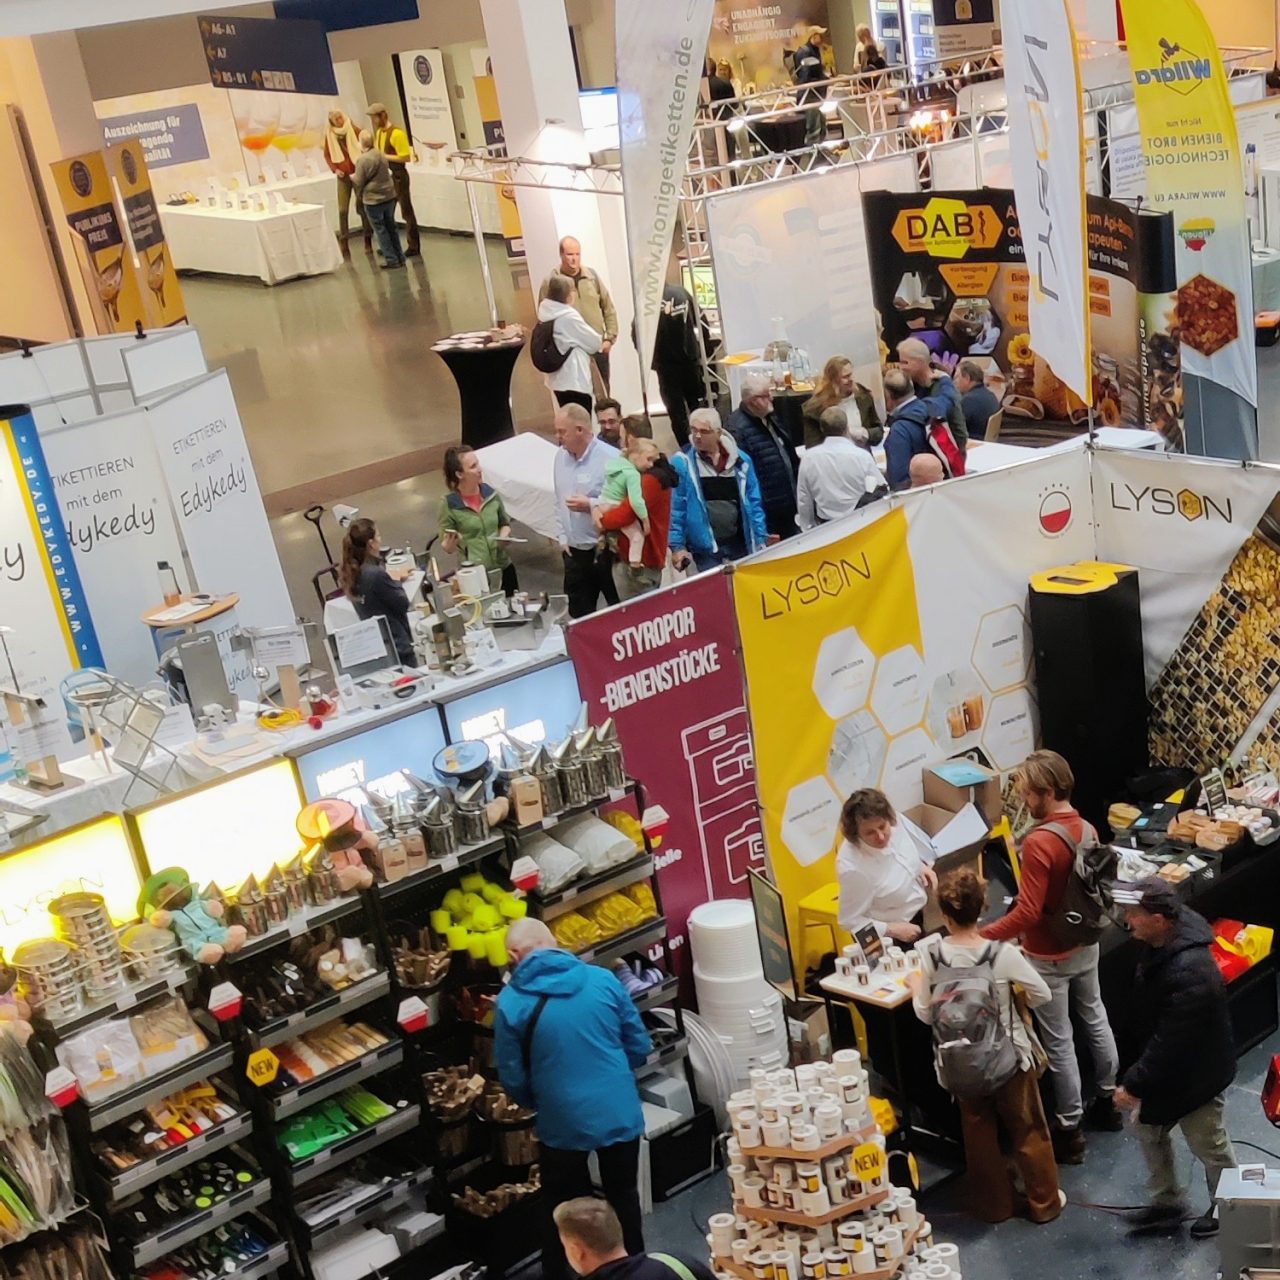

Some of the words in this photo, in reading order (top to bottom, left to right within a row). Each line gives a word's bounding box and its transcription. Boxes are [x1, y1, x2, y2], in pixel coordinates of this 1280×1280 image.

[104, 119, 166, 139] Auszeichnung
[166, 115, 180, 128] für
[643, 36, 693, 318] www.honigetiketten.de
[905, 212, 975, 240] DAB
[172, 418, 227, 455] ETIKETTIEREN
[50, 456, 134, 489] TIKETTIEREN
[191, 457, 206, 472] mit
[205, 447, 224, 468] dem
[66, 496, 90, 511] mit
[93, 486, 123, 505] dem
[180, 463, 248, 518] Edykedy
[1109, 480, 1234, 524] LYSON
[65, 503, 155, 553] dykedy
[760, 551, 871, 621] LYSON
[611, 606, 696, 662] STYROPOR
[600, 642, 721, 713] -BIENENSTÖCKE
[250, 1057, 274, 1078] NEW
[854, 1152, 879, 1173] NEW
